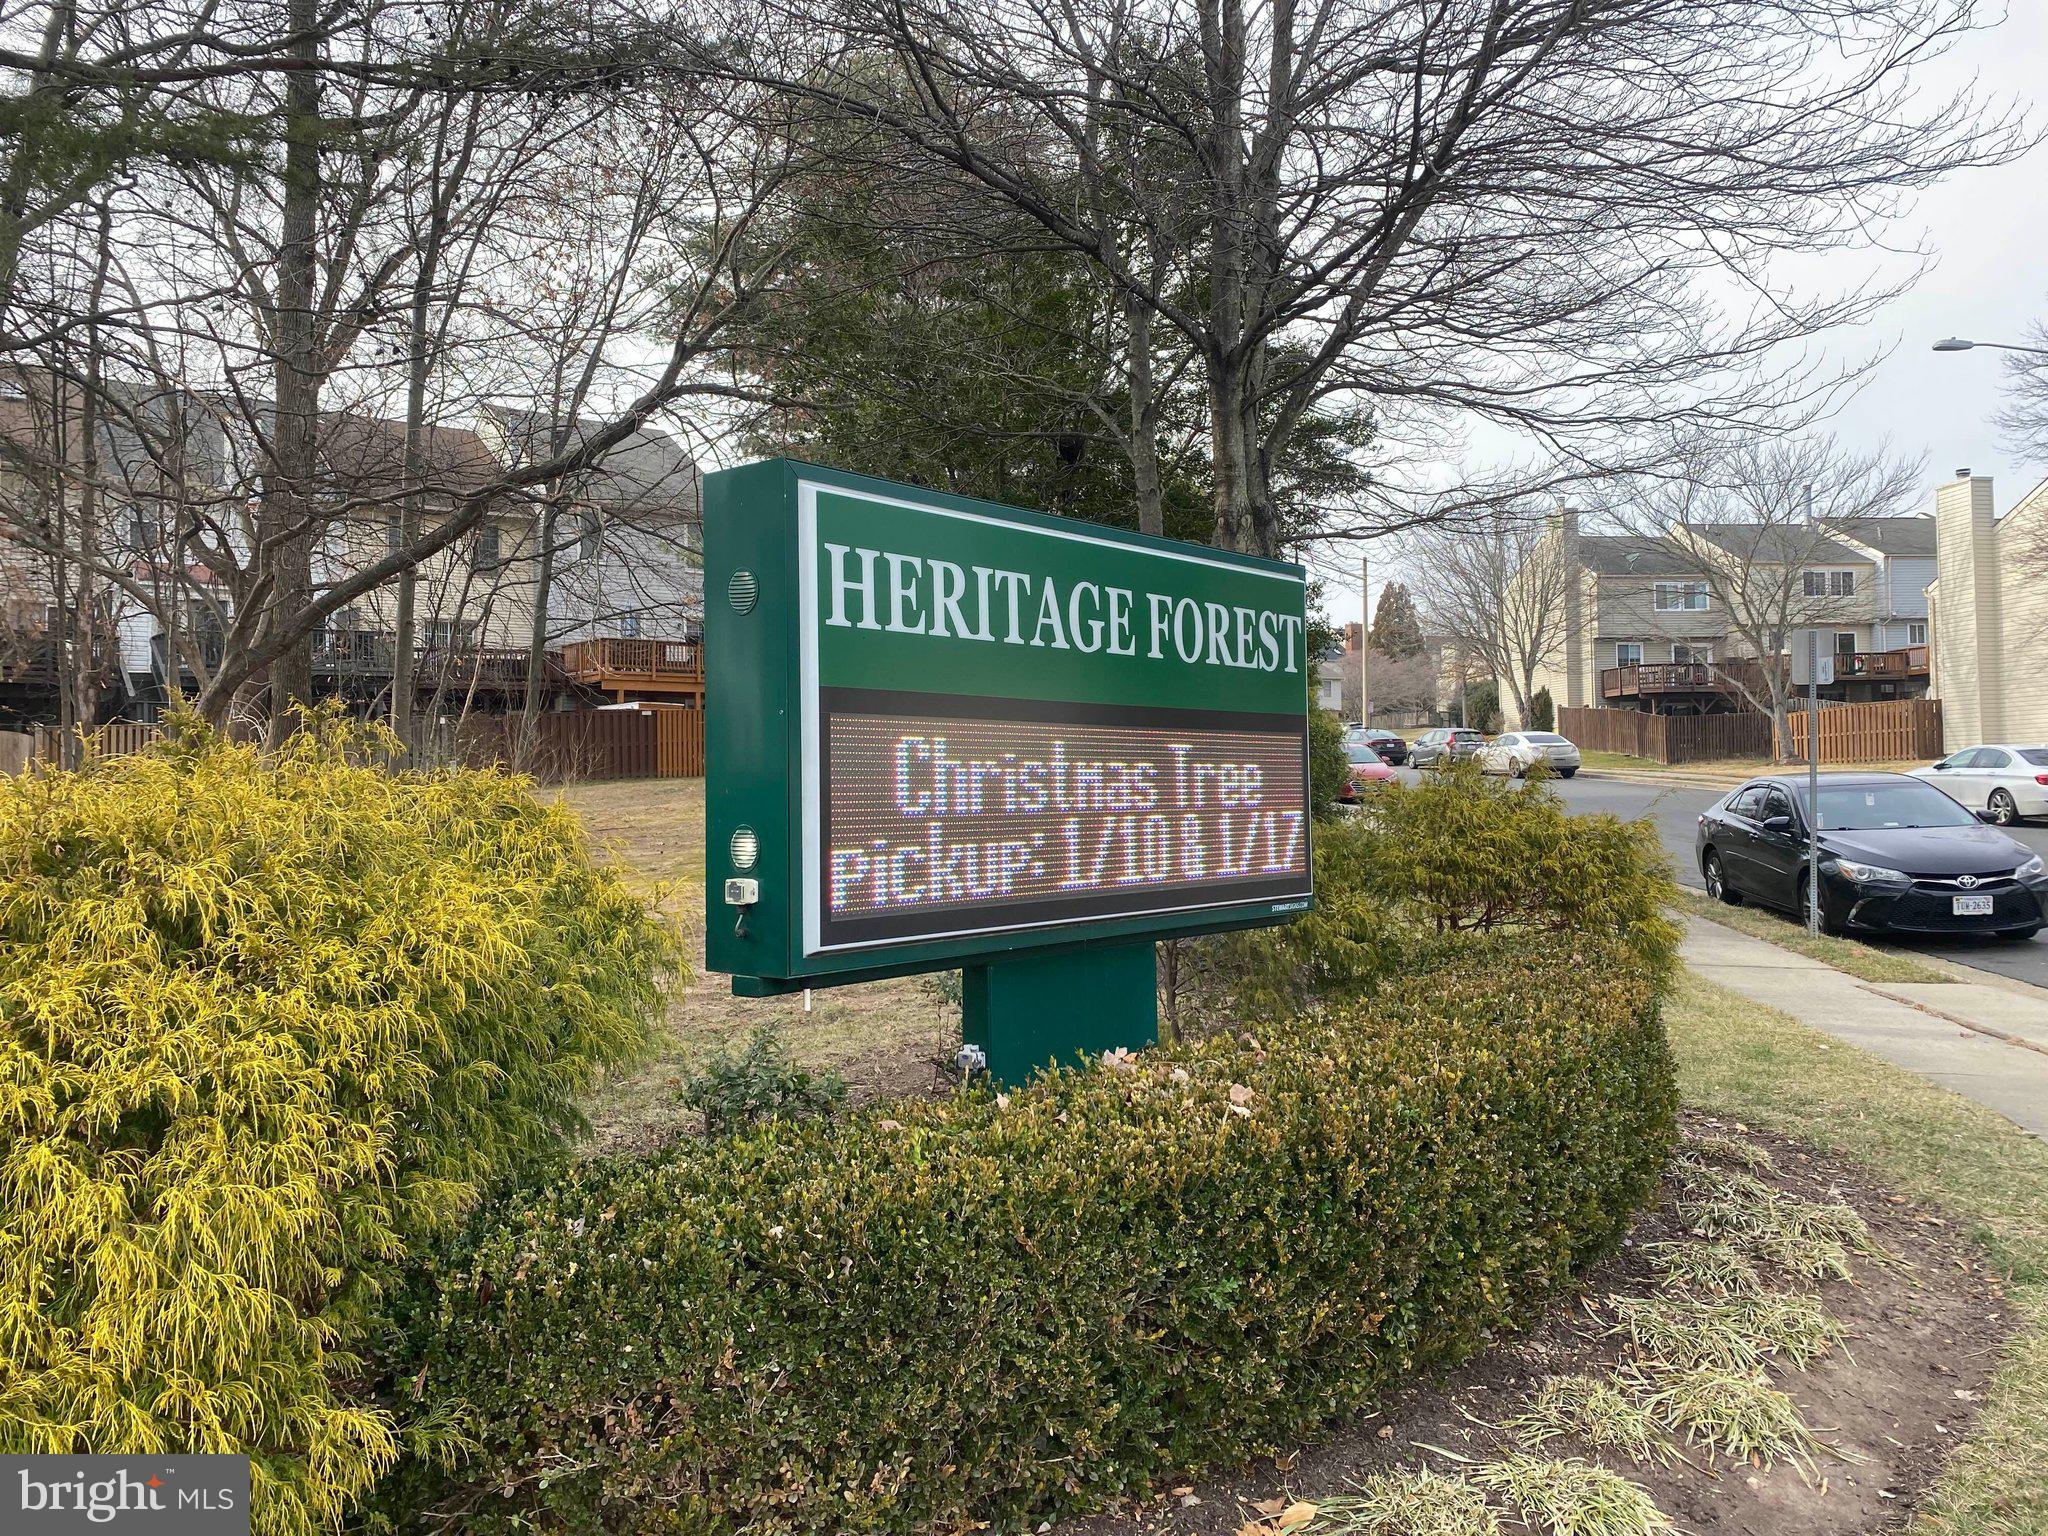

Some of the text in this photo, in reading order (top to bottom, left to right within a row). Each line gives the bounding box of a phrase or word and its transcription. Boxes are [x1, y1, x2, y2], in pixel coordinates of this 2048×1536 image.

[824, 541, 1302, 674] HERITAGE FOREST
[896, 736, 1263, 816] Christmas Tree
[1058, 815, 1168, 889] 1/10
[1181, 814, 1206, 878] &
[1217, 811, 1303, 877] 1/17
